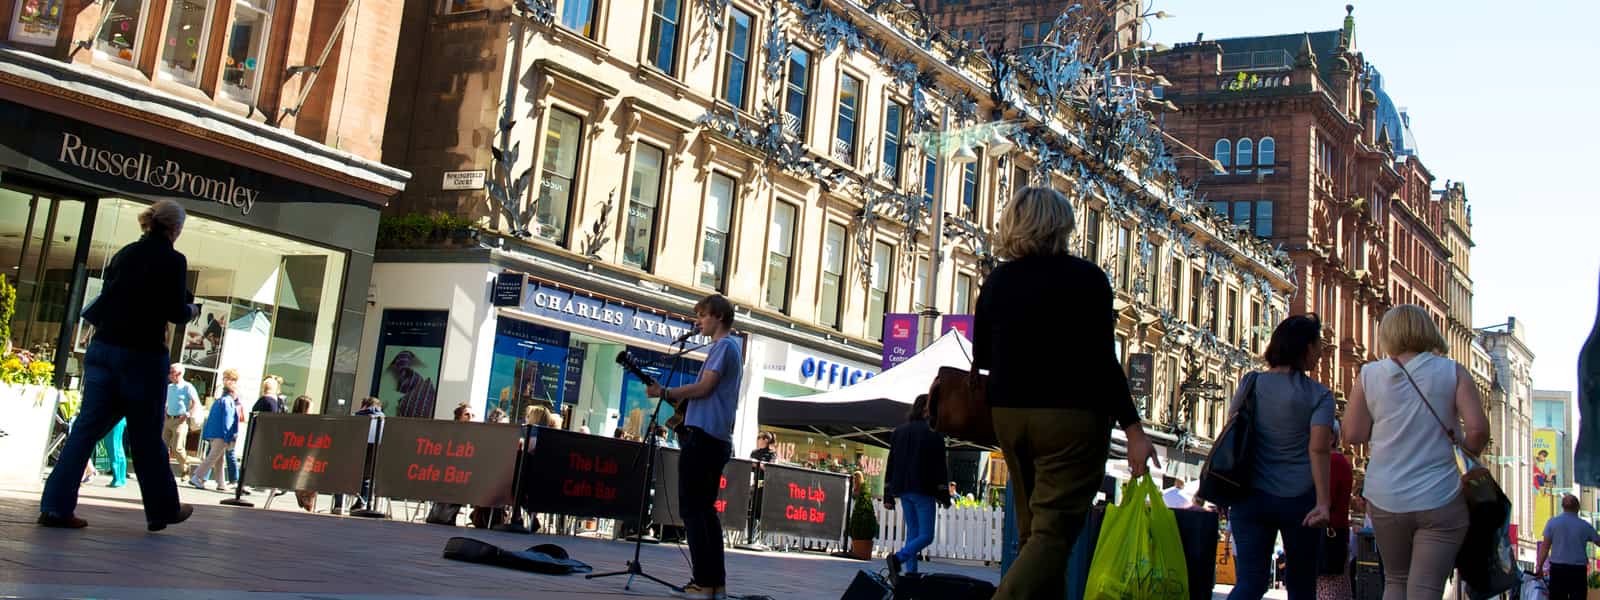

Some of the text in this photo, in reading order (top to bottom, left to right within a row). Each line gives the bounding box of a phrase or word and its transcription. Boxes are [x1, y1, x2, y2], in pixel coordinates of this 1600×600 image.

[535, 292, 624, 326] CHARLES
[893, 345, 906, 355] City
[282, 431, 332, 449] The Lab
[416, 437, 476, 458] The Lab
[272, 454, 329, 473] Cafe Bar
[407, 463, 473, 484] Cafe Bar
[568, 453, 619, 474] The Lab
[562, 479, 617, 499] Cafe Bar
[788, 482, 825, 502] The Lab
[712, 500, 727, 513] ar
[785, 505, 826, 523] Cafe Bar
